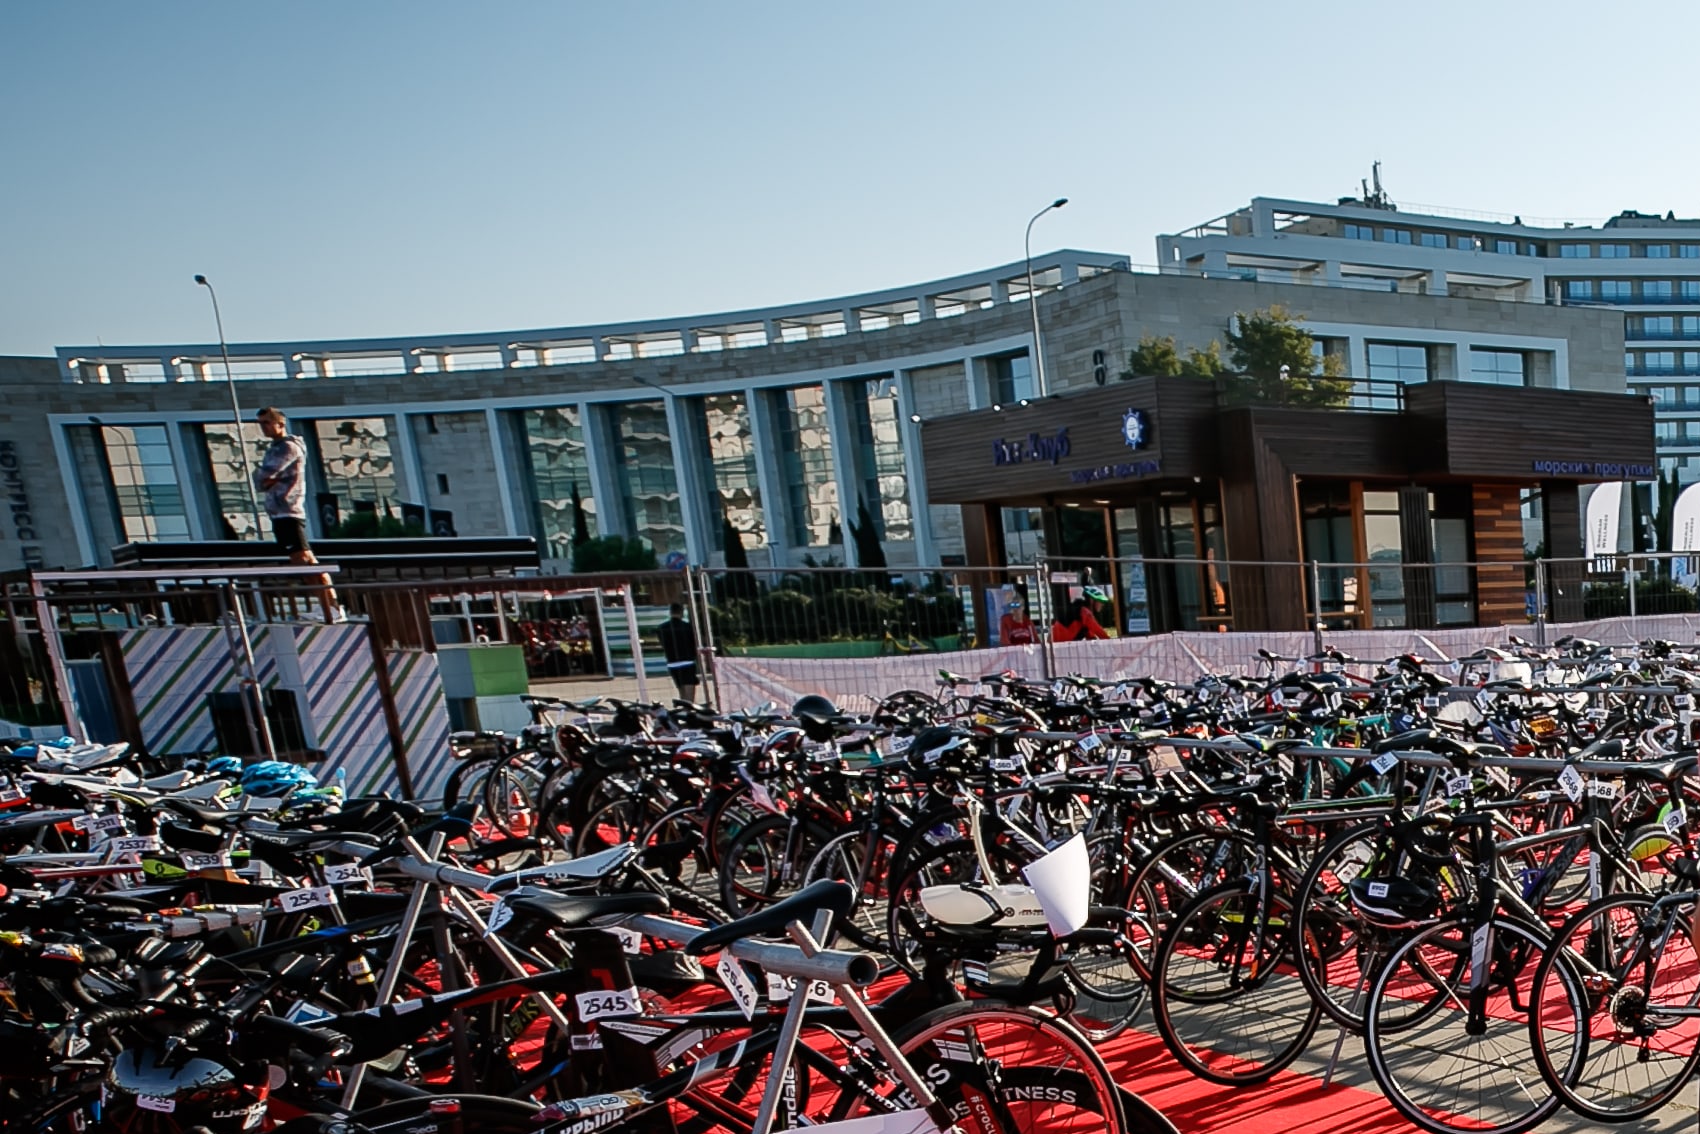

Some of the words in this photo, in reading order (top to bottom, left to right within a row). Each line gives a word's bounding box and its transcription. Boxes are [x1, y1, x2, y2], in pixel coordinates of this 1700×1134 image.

[1594, 463, 1653, 476] прогулки
[1562, 772, 1579, 795] 2568
[118, 839, 147, 850] 2537
[721, 962, 751, 1008] 2546
[583, 997, 629, 1016] 2545
